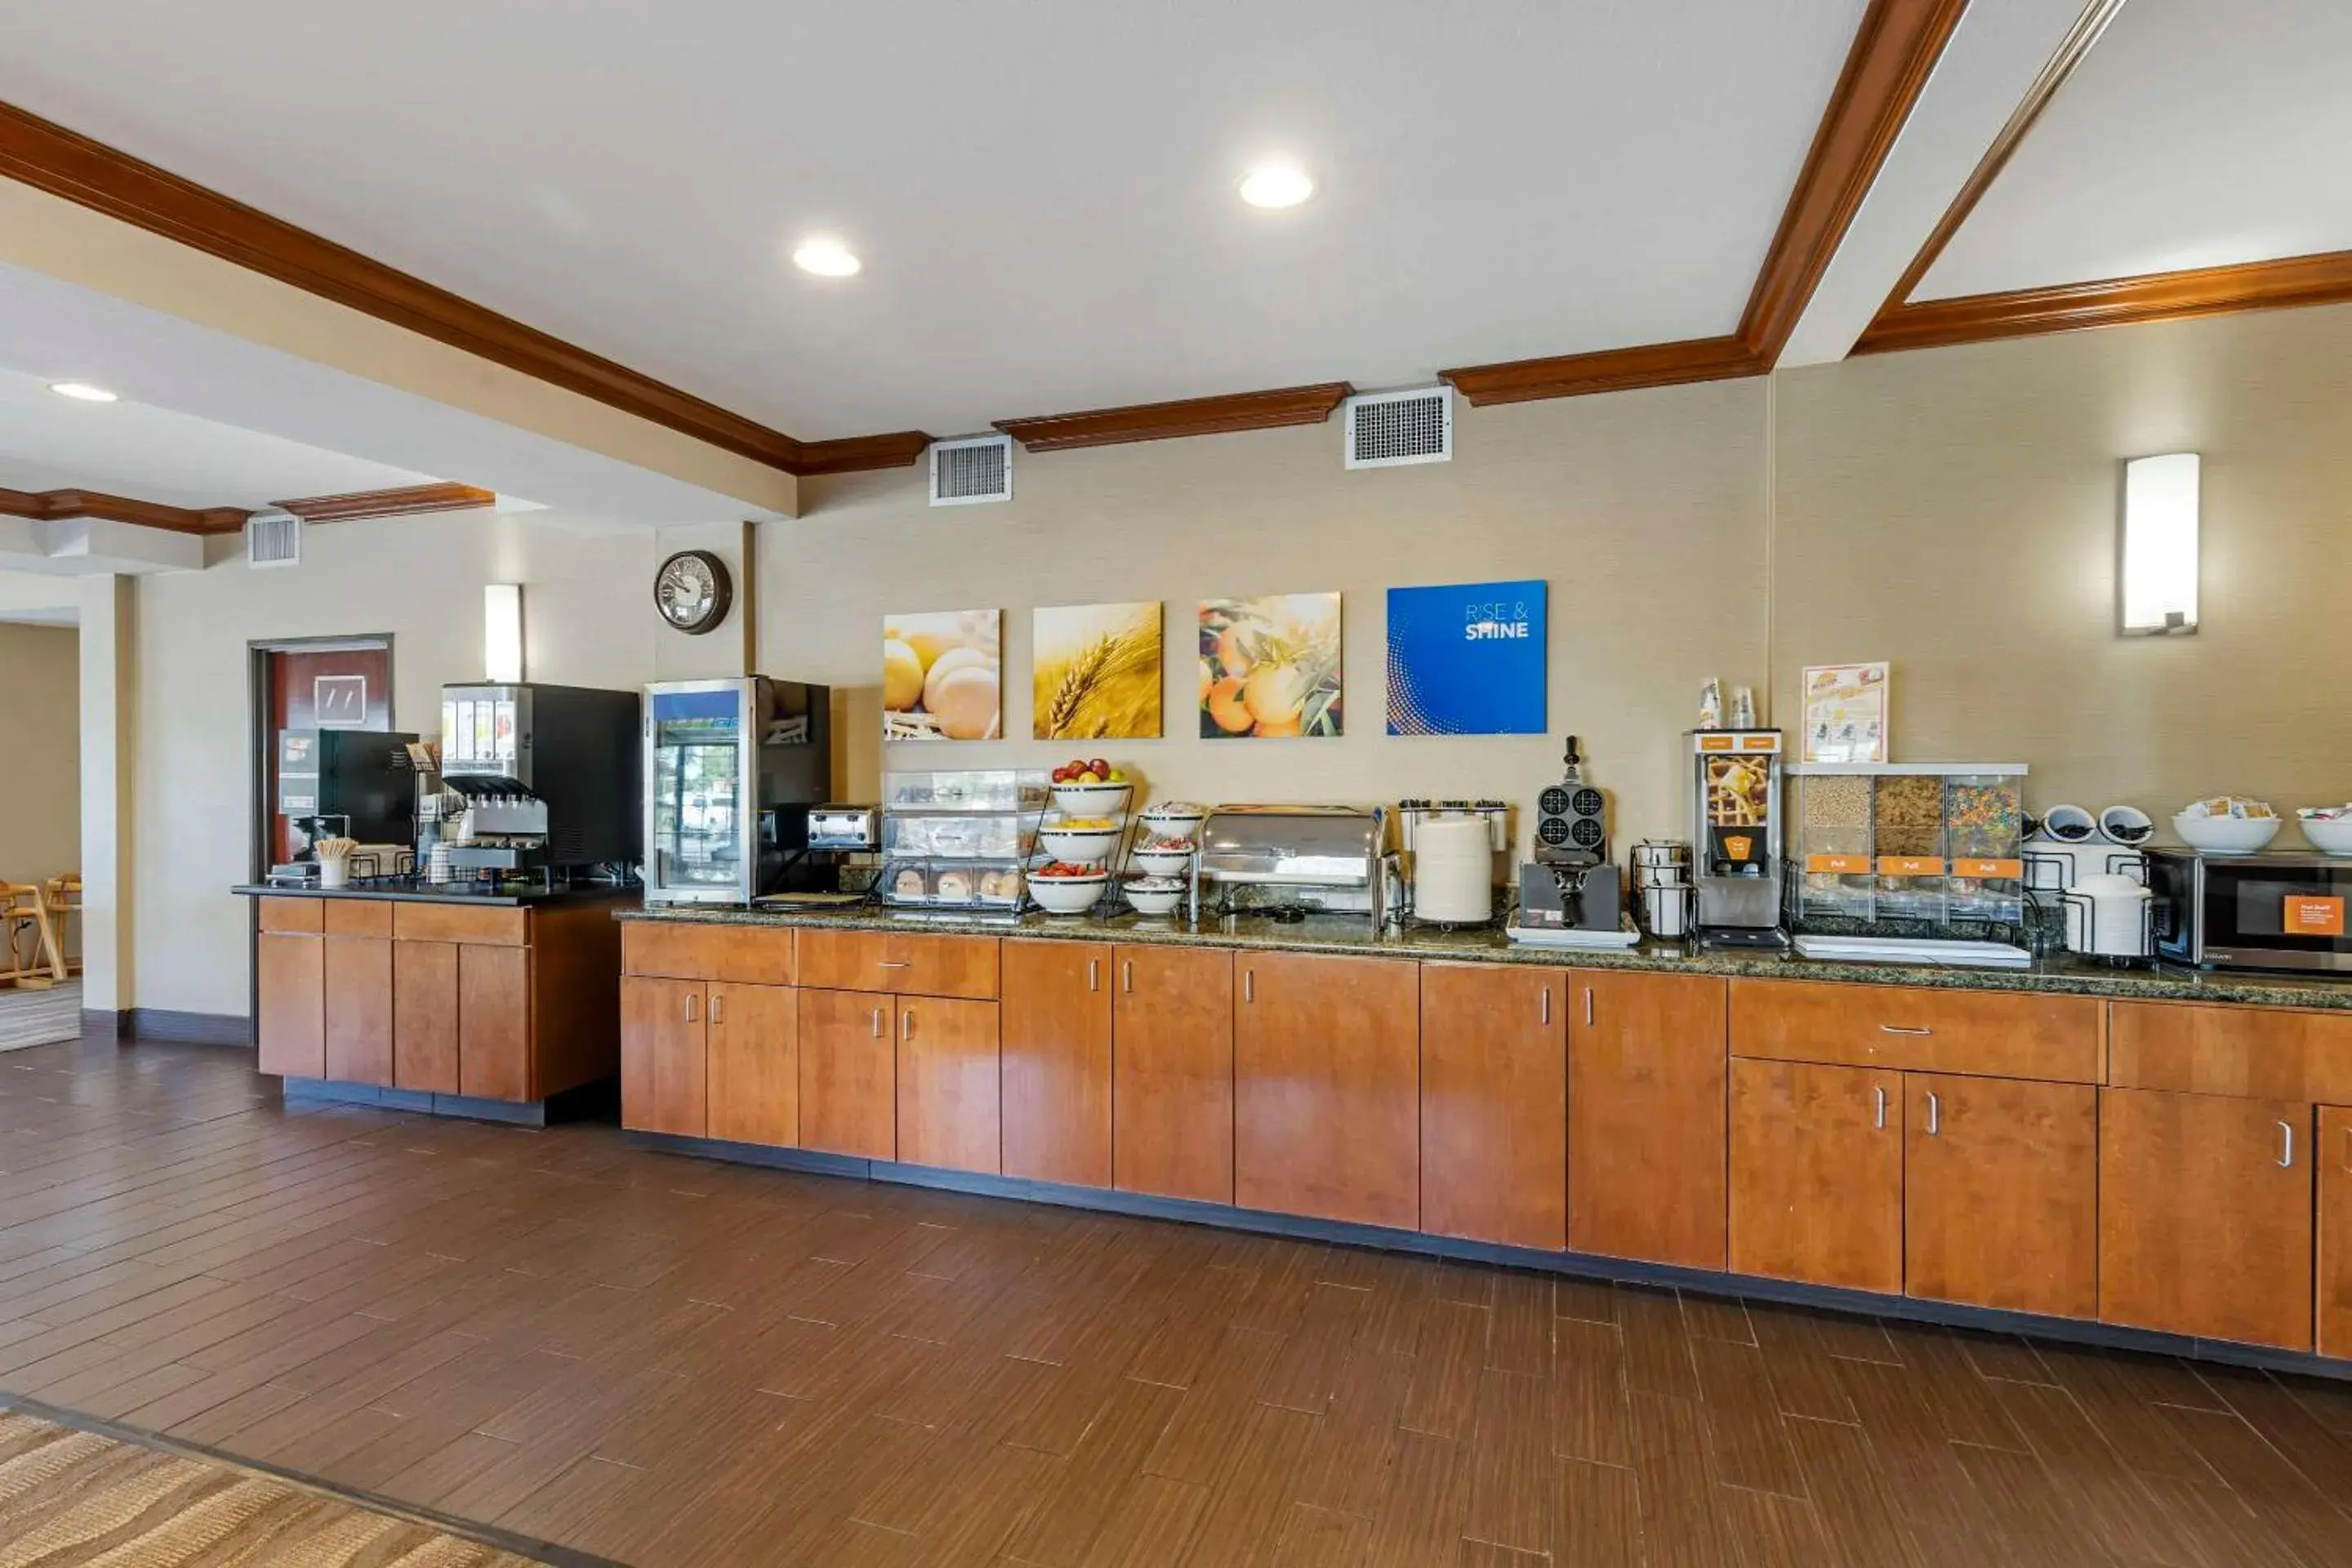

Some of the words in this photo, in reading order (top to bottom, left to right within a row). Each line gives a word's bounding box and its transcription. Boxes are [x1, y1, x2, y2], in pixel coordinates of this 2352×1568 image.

[1466, 603, 1507, 621] RISE
[1513, 601, 1529, 620] &
[1465, 621, 1530, 640] SHINE
